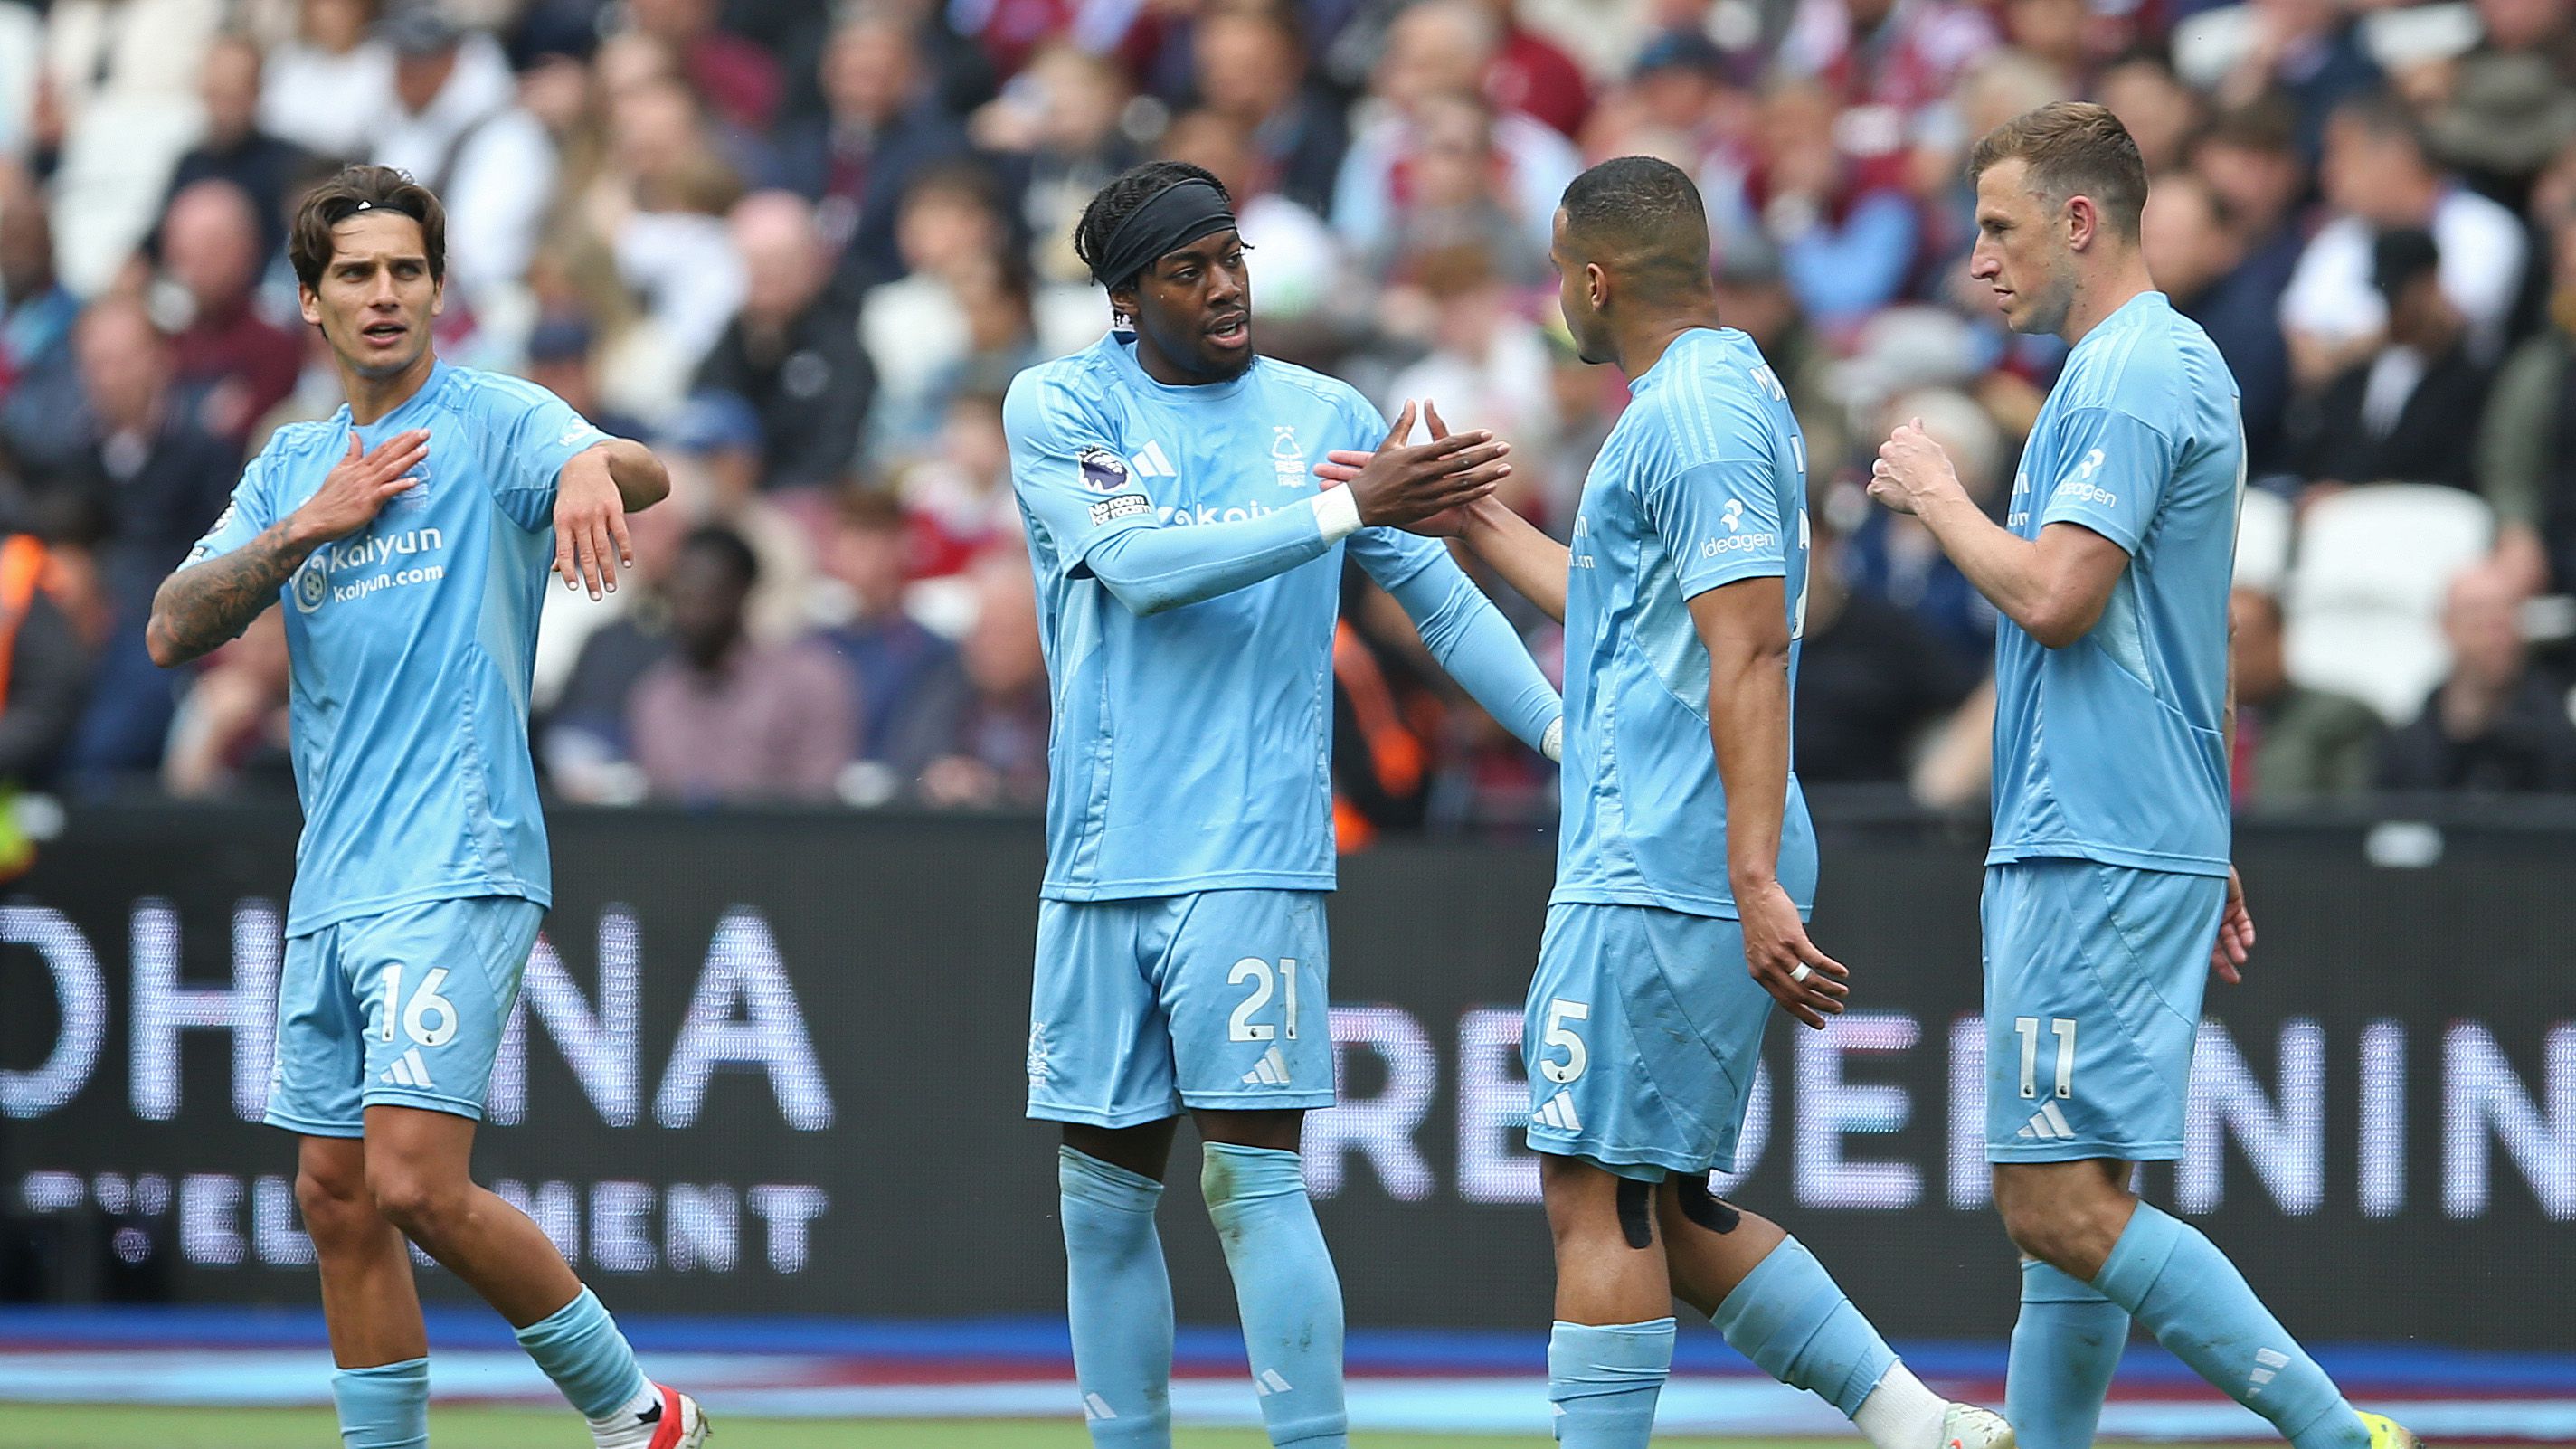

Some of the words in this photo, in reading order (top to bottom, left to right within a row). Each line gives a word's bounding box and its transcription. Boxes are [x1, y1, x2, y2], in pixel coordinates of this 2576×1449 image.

[1088, 503, 1109, 516] No
[1108, 495, 1145, 509] room
[1092, 511, 1110, 526] for
[329, 527, 442, 573] kaiyun
[1700, 532, 1775, 559] Ideagen
[333, 564, 443, 603] kaiyun.com
[381, 963, 458, 1047] 16
[1227, 956, 1298, 1041] 21
[1540, 999, 1588, 1084] 5
[2015, 1017, 2077, 1099] 11
